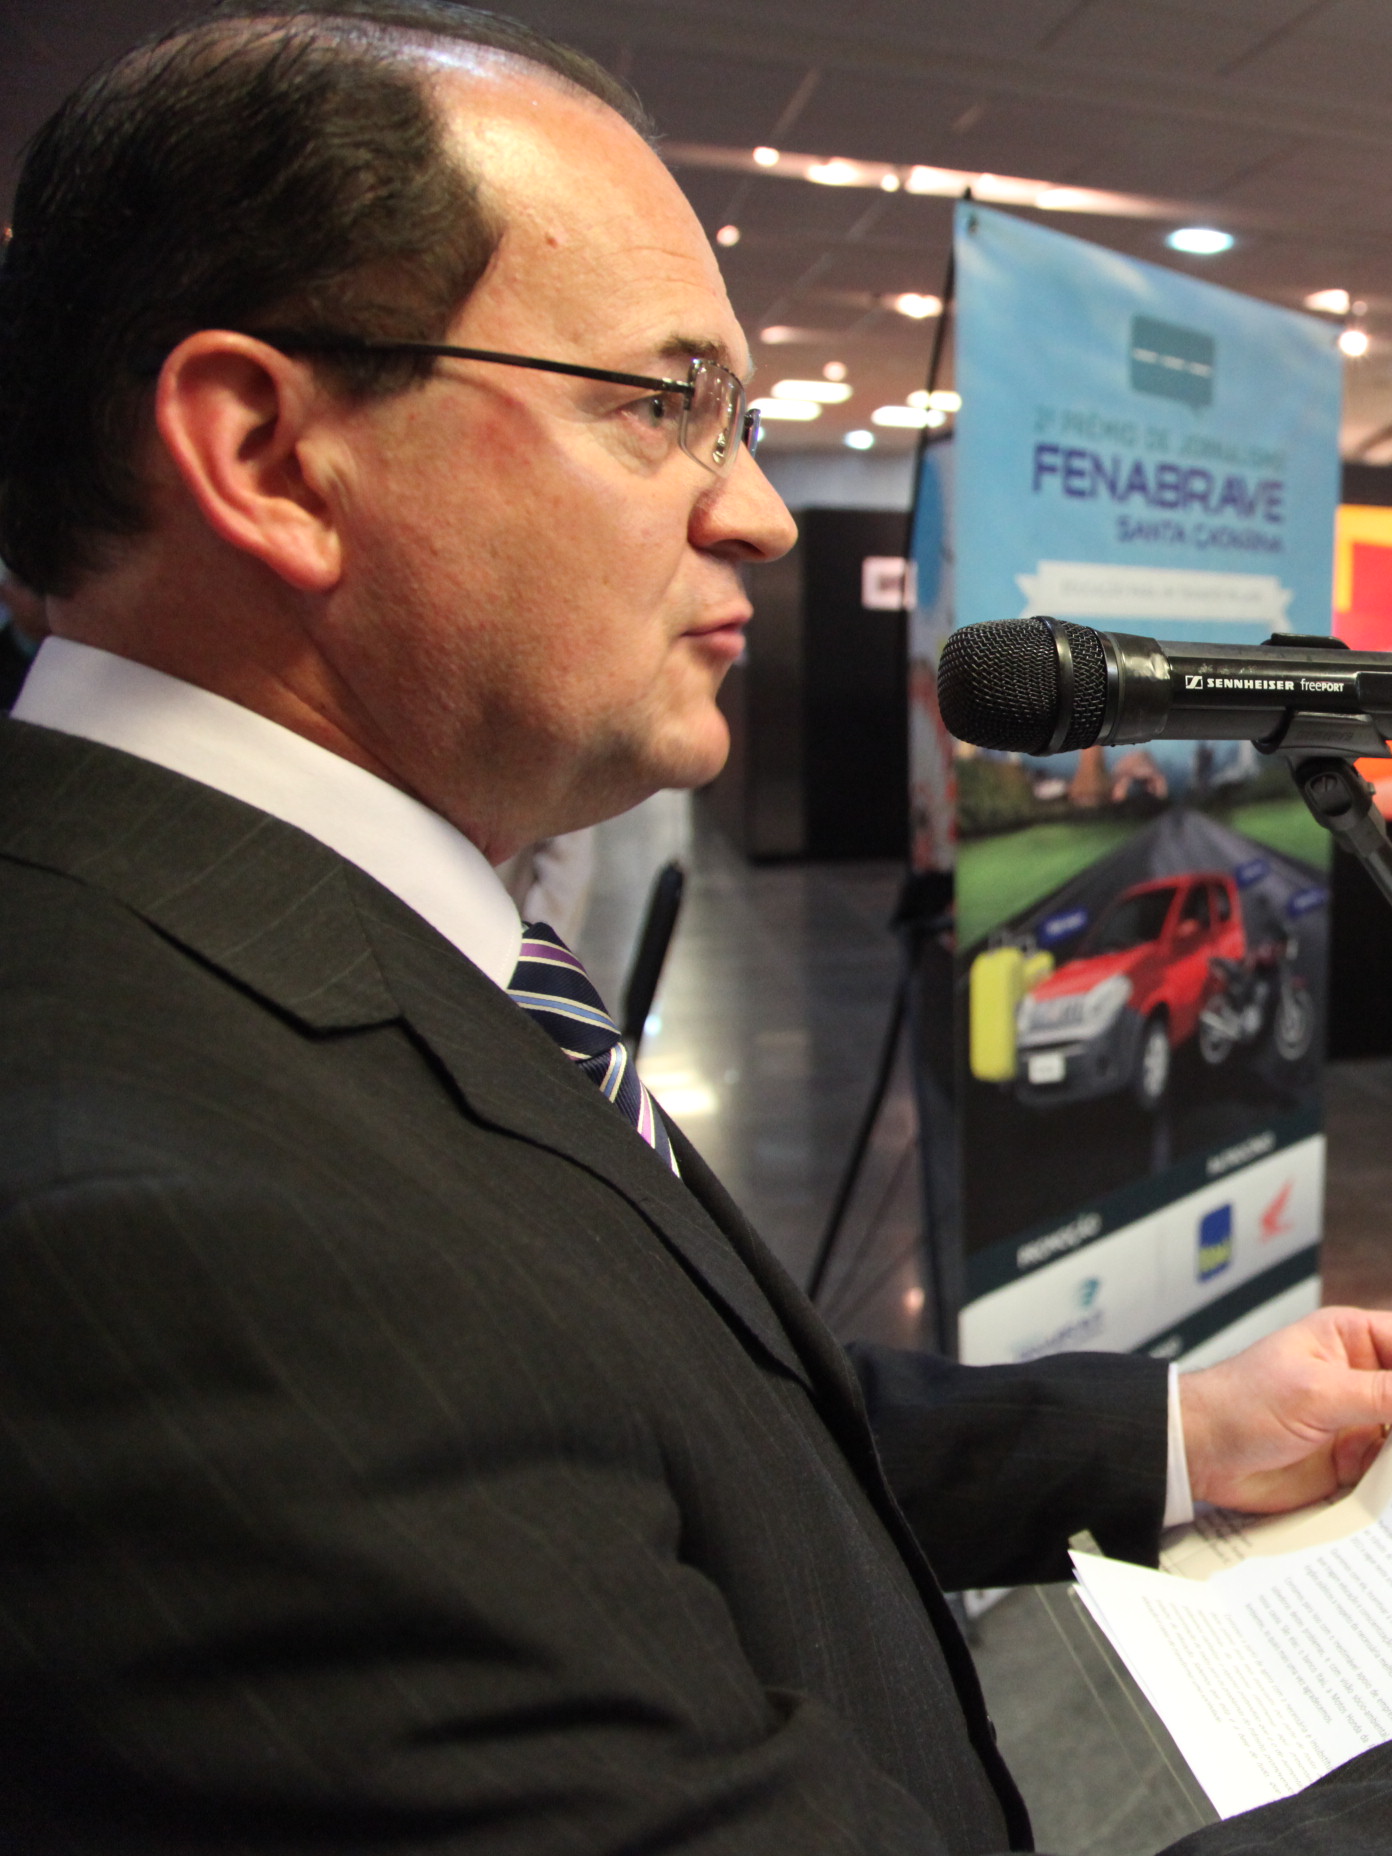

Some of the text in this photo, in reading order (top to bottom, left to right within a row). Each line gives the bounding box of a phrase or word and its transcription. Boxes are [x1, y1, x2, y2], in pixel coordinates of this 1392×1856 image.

[1032, 443, 1285, 525] FENABRAVE
[1116, 514, 1187, 545] SANTA
[1207, 678, 1345, 693] SENNHEISER freePORT
